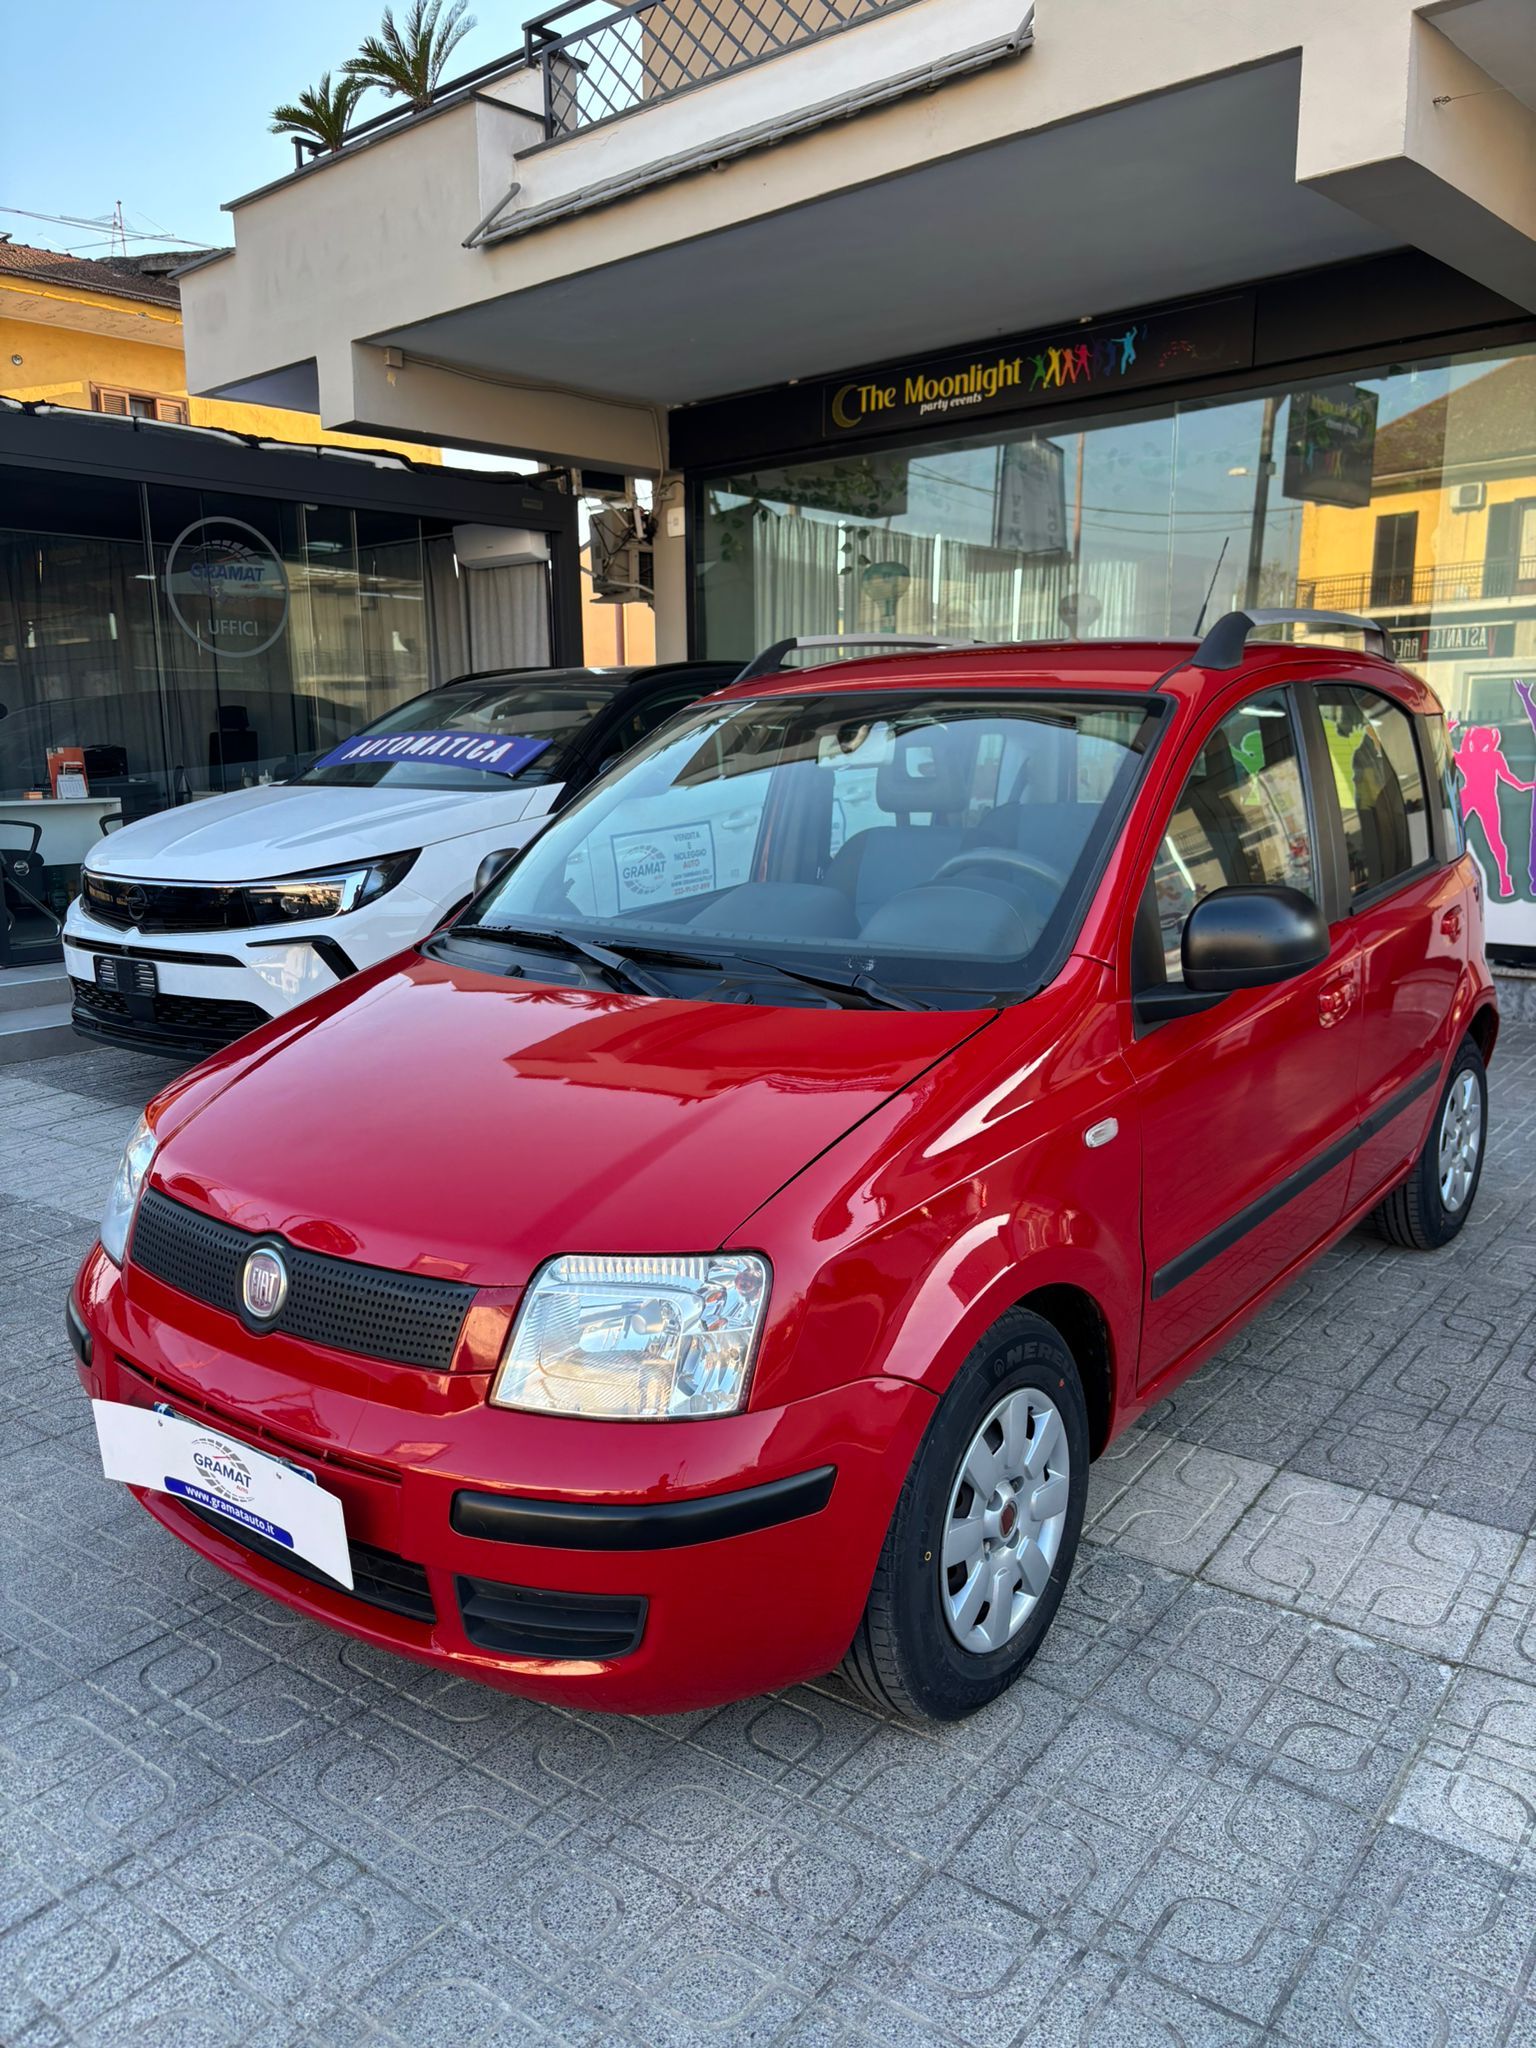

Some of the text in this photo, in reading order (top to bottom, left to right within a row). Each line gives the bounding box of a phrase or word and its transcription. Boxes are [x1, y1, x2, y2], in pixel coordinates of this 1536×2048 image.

[857, 357, 1023, 413] The Moonlight
[920, 393, 982, 415] party events
[190, 560, 265, 582] GRAMAT
[207, 618, 259, 637] UFFICI
[341, 735, 514, 764] AUTOMATICA
[622, 860, 667, 880] GRAMAT
[251, 1267, 278, 1303] FIAT
[193, 1452, 252, 1489] GRAMAT
[185, 1485, 275, 1536] www.gramatauto.it
